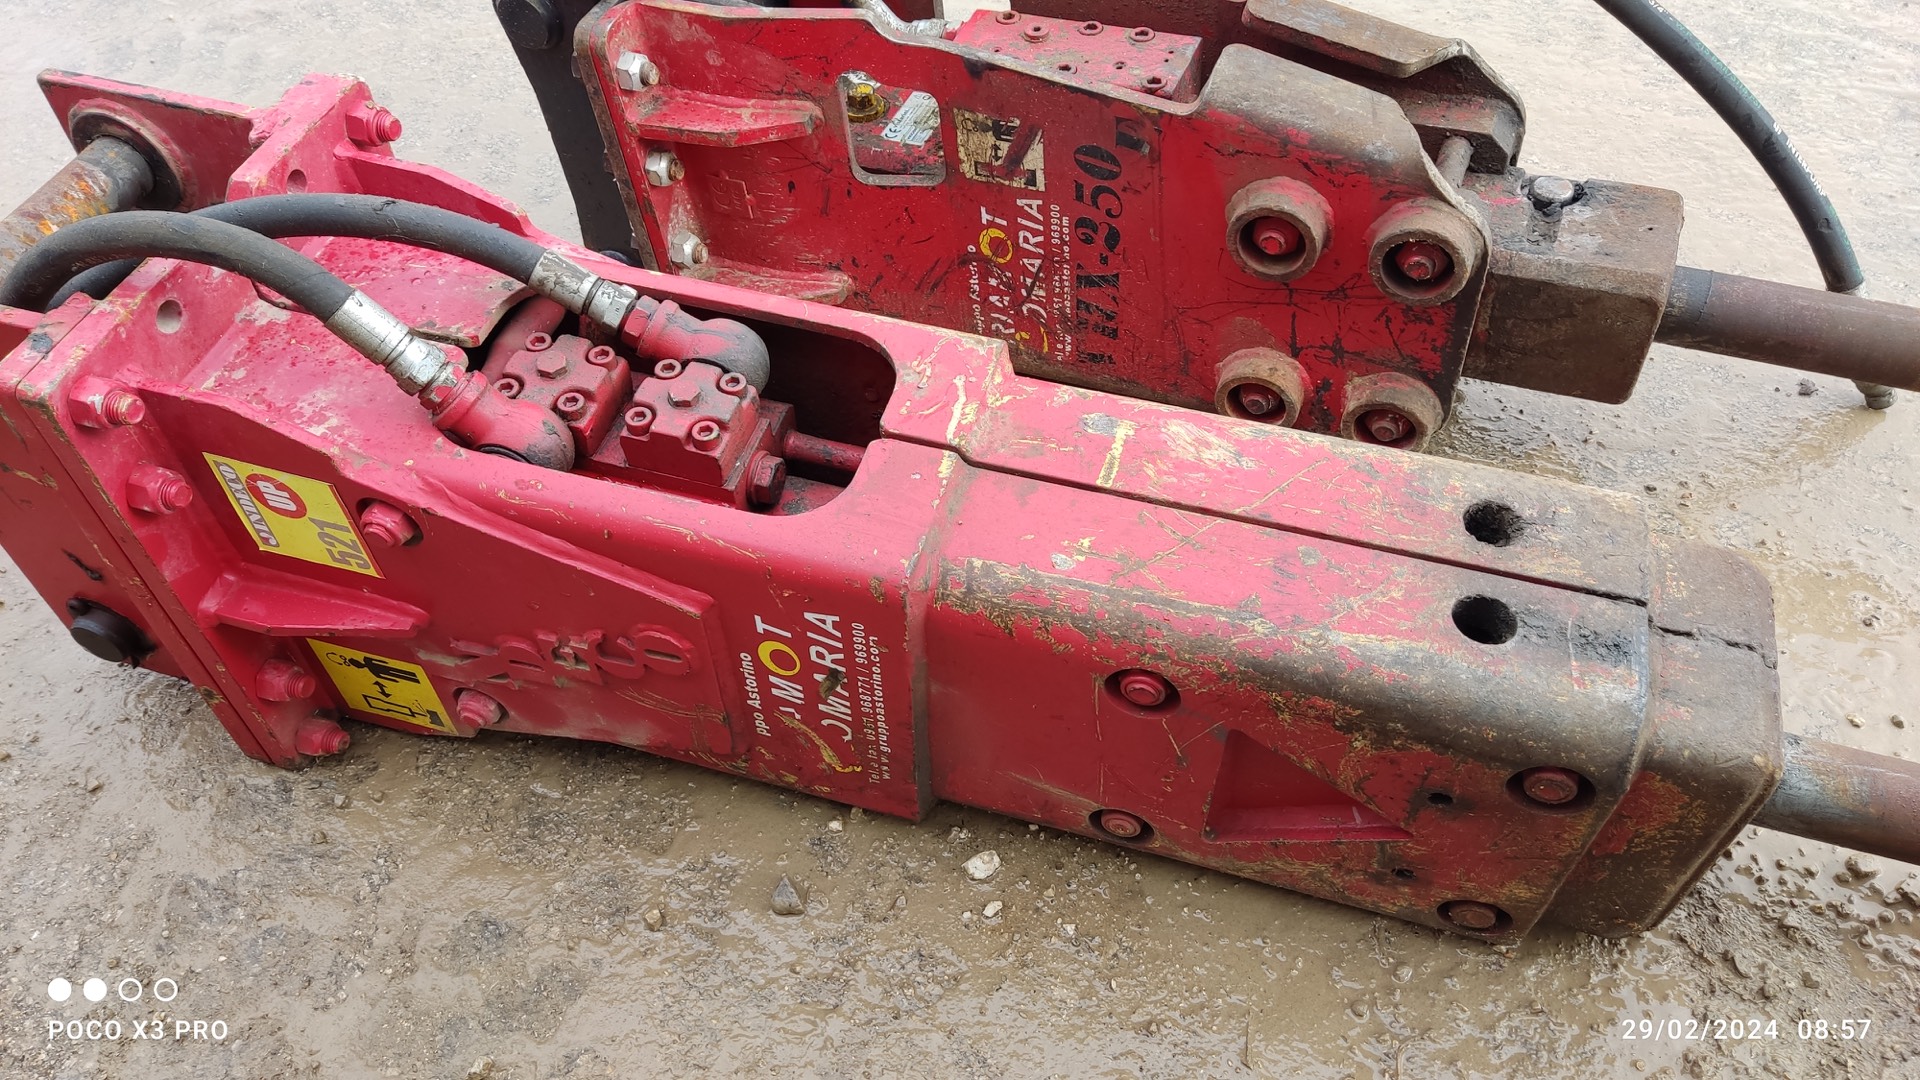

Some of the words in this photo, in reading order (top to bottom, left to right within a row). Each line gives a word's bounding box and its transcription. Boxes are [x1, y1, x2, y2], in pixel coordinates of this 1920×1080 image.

[1050, 204, 1061, 245] 969900
[217, 463, 277, 546] INDECO
[255, 480, 298, 512] UP
[308, 516, 372, 570] 521
[851, 622, 869, 665] 969900
[739, 652, 763, 710] Astorino
